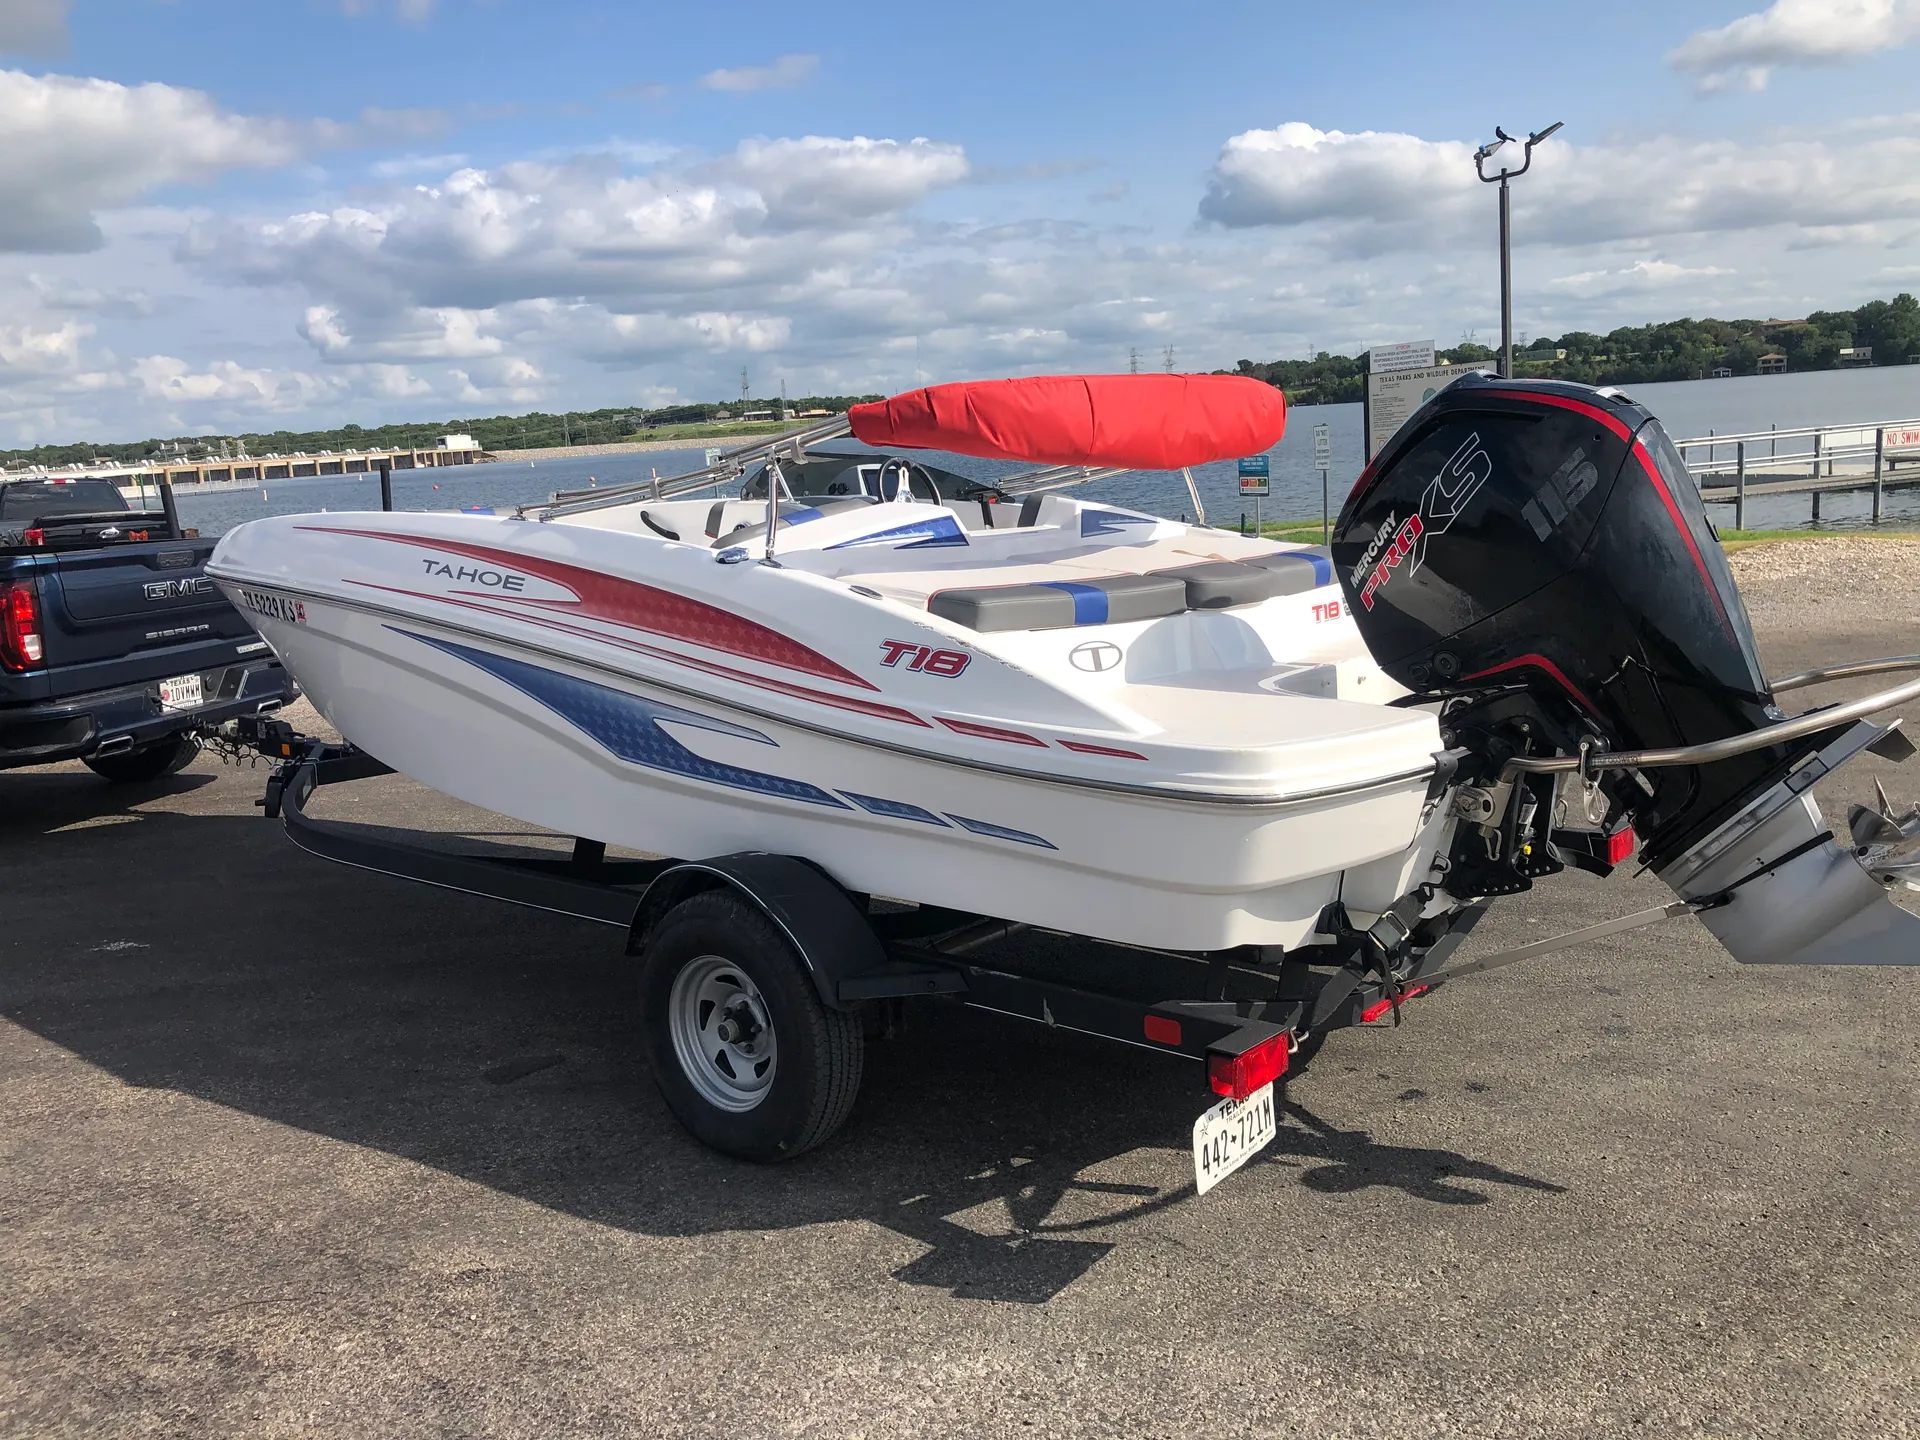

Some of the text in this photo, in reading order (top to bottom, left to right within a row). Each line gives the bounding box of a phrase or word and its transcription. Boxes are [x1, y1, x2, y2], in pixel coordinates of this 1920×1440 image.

[1396, 373, 1412, 381] PARKS
[1426, 369, 1449, 378] WILDLIFE
[1886, 433, 1898, 445] NO
[1521, 446, 1599, 543] 115
[1350, 509, 1398, 588] MERCURY
[1360, 513, 1424, 612] PRO
[422, 559, 526, 592] TAHOE
[143, 577, 213, 601] GMC
[254, 593, 280, 619] 5229
[1311, 601, 1340, 624] T18
[145, 624, 210, 639] SIERRA
[880, 638, 972, 678] T18
[170, 679, 190, 687] TEXAS
[1225, 1105, 1247, 1124] TRAILER
